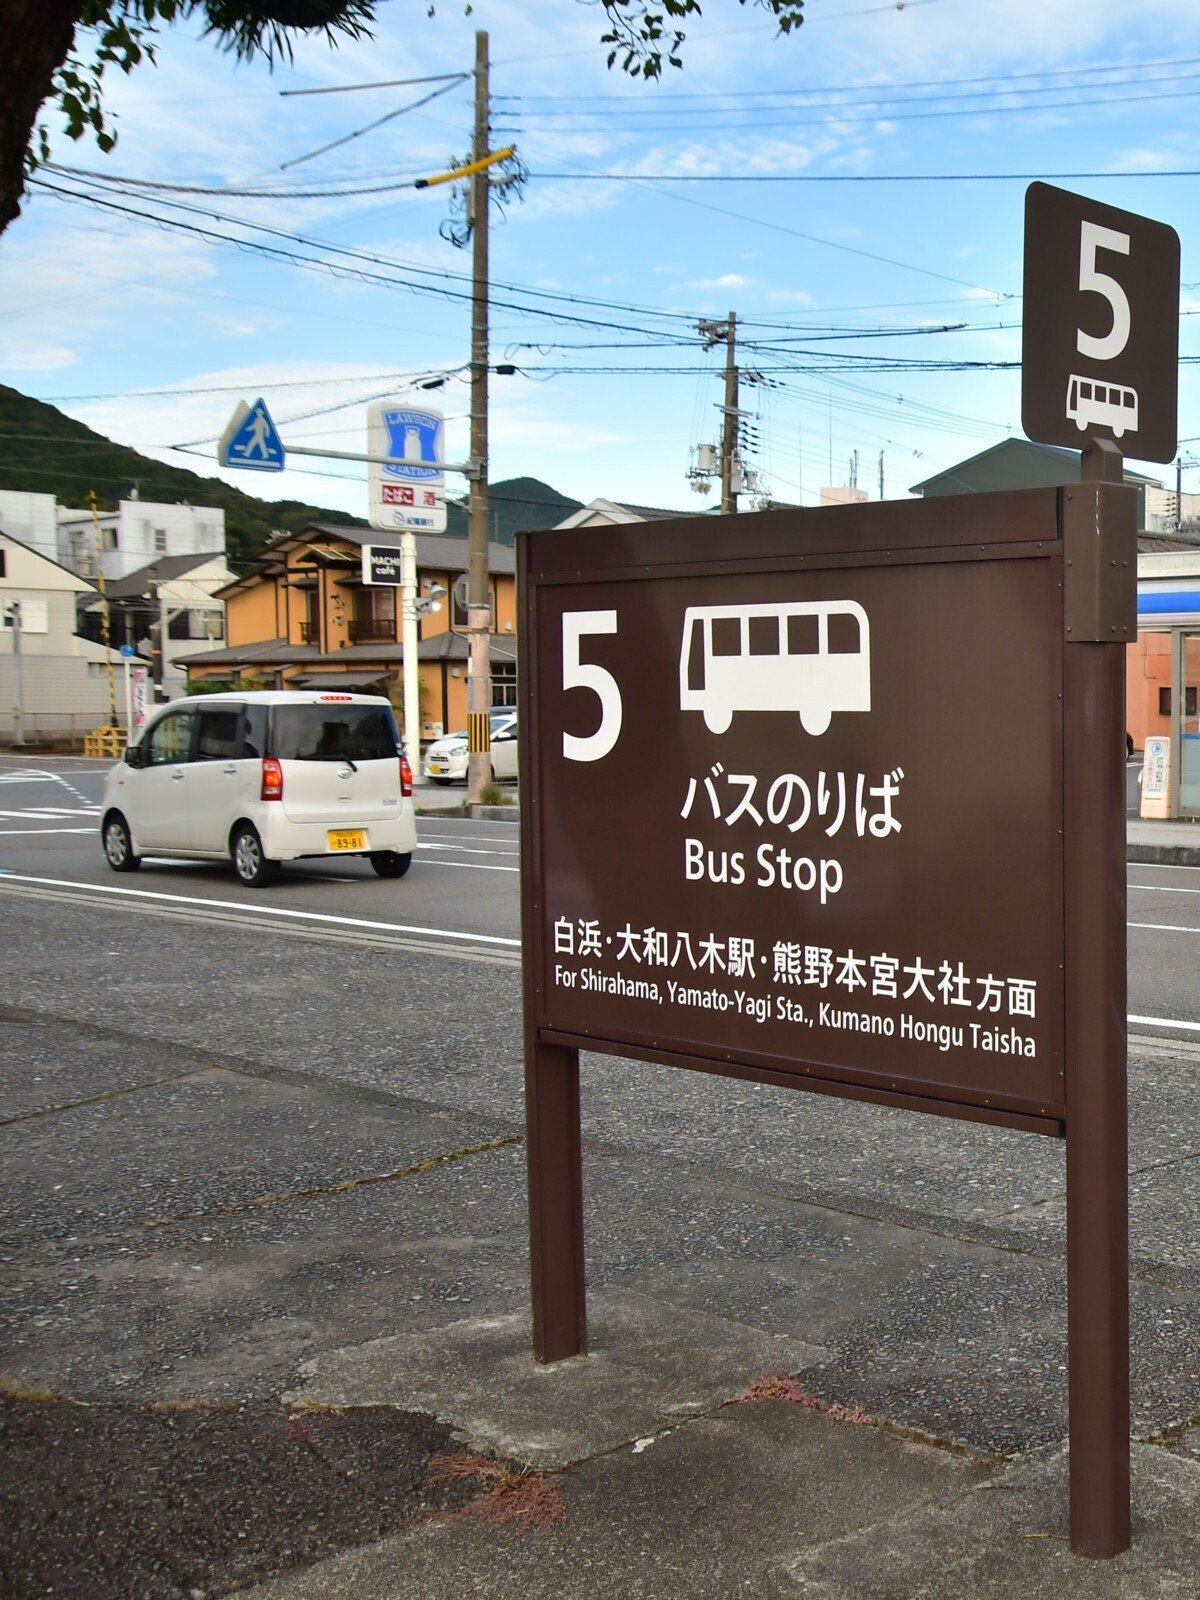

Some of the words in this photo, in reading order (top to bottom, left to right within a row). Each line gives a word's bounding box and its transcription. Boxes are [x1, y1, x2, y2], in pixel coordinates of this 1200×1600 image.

[1077, 220, 1131, 360] 5
[563, 610, 622, 761] 5
[681, 762, 904, 837] バスのりば
[686, 839, 745, 884] Bus
[757, 844, 842, 904] Stop
[555, 965, 577, 987] For
[581, 968, 662, 1004] Shirahama,
[667, 981, 770, 1023] Yamato-Yagi
[777, 997, 813, 1027] Sta.,
[820, 1003, 894, 1036] Kumano
[901, 1014, 962, 1051] Hongu
[970, 1024, 1035, 1057] Taisha
